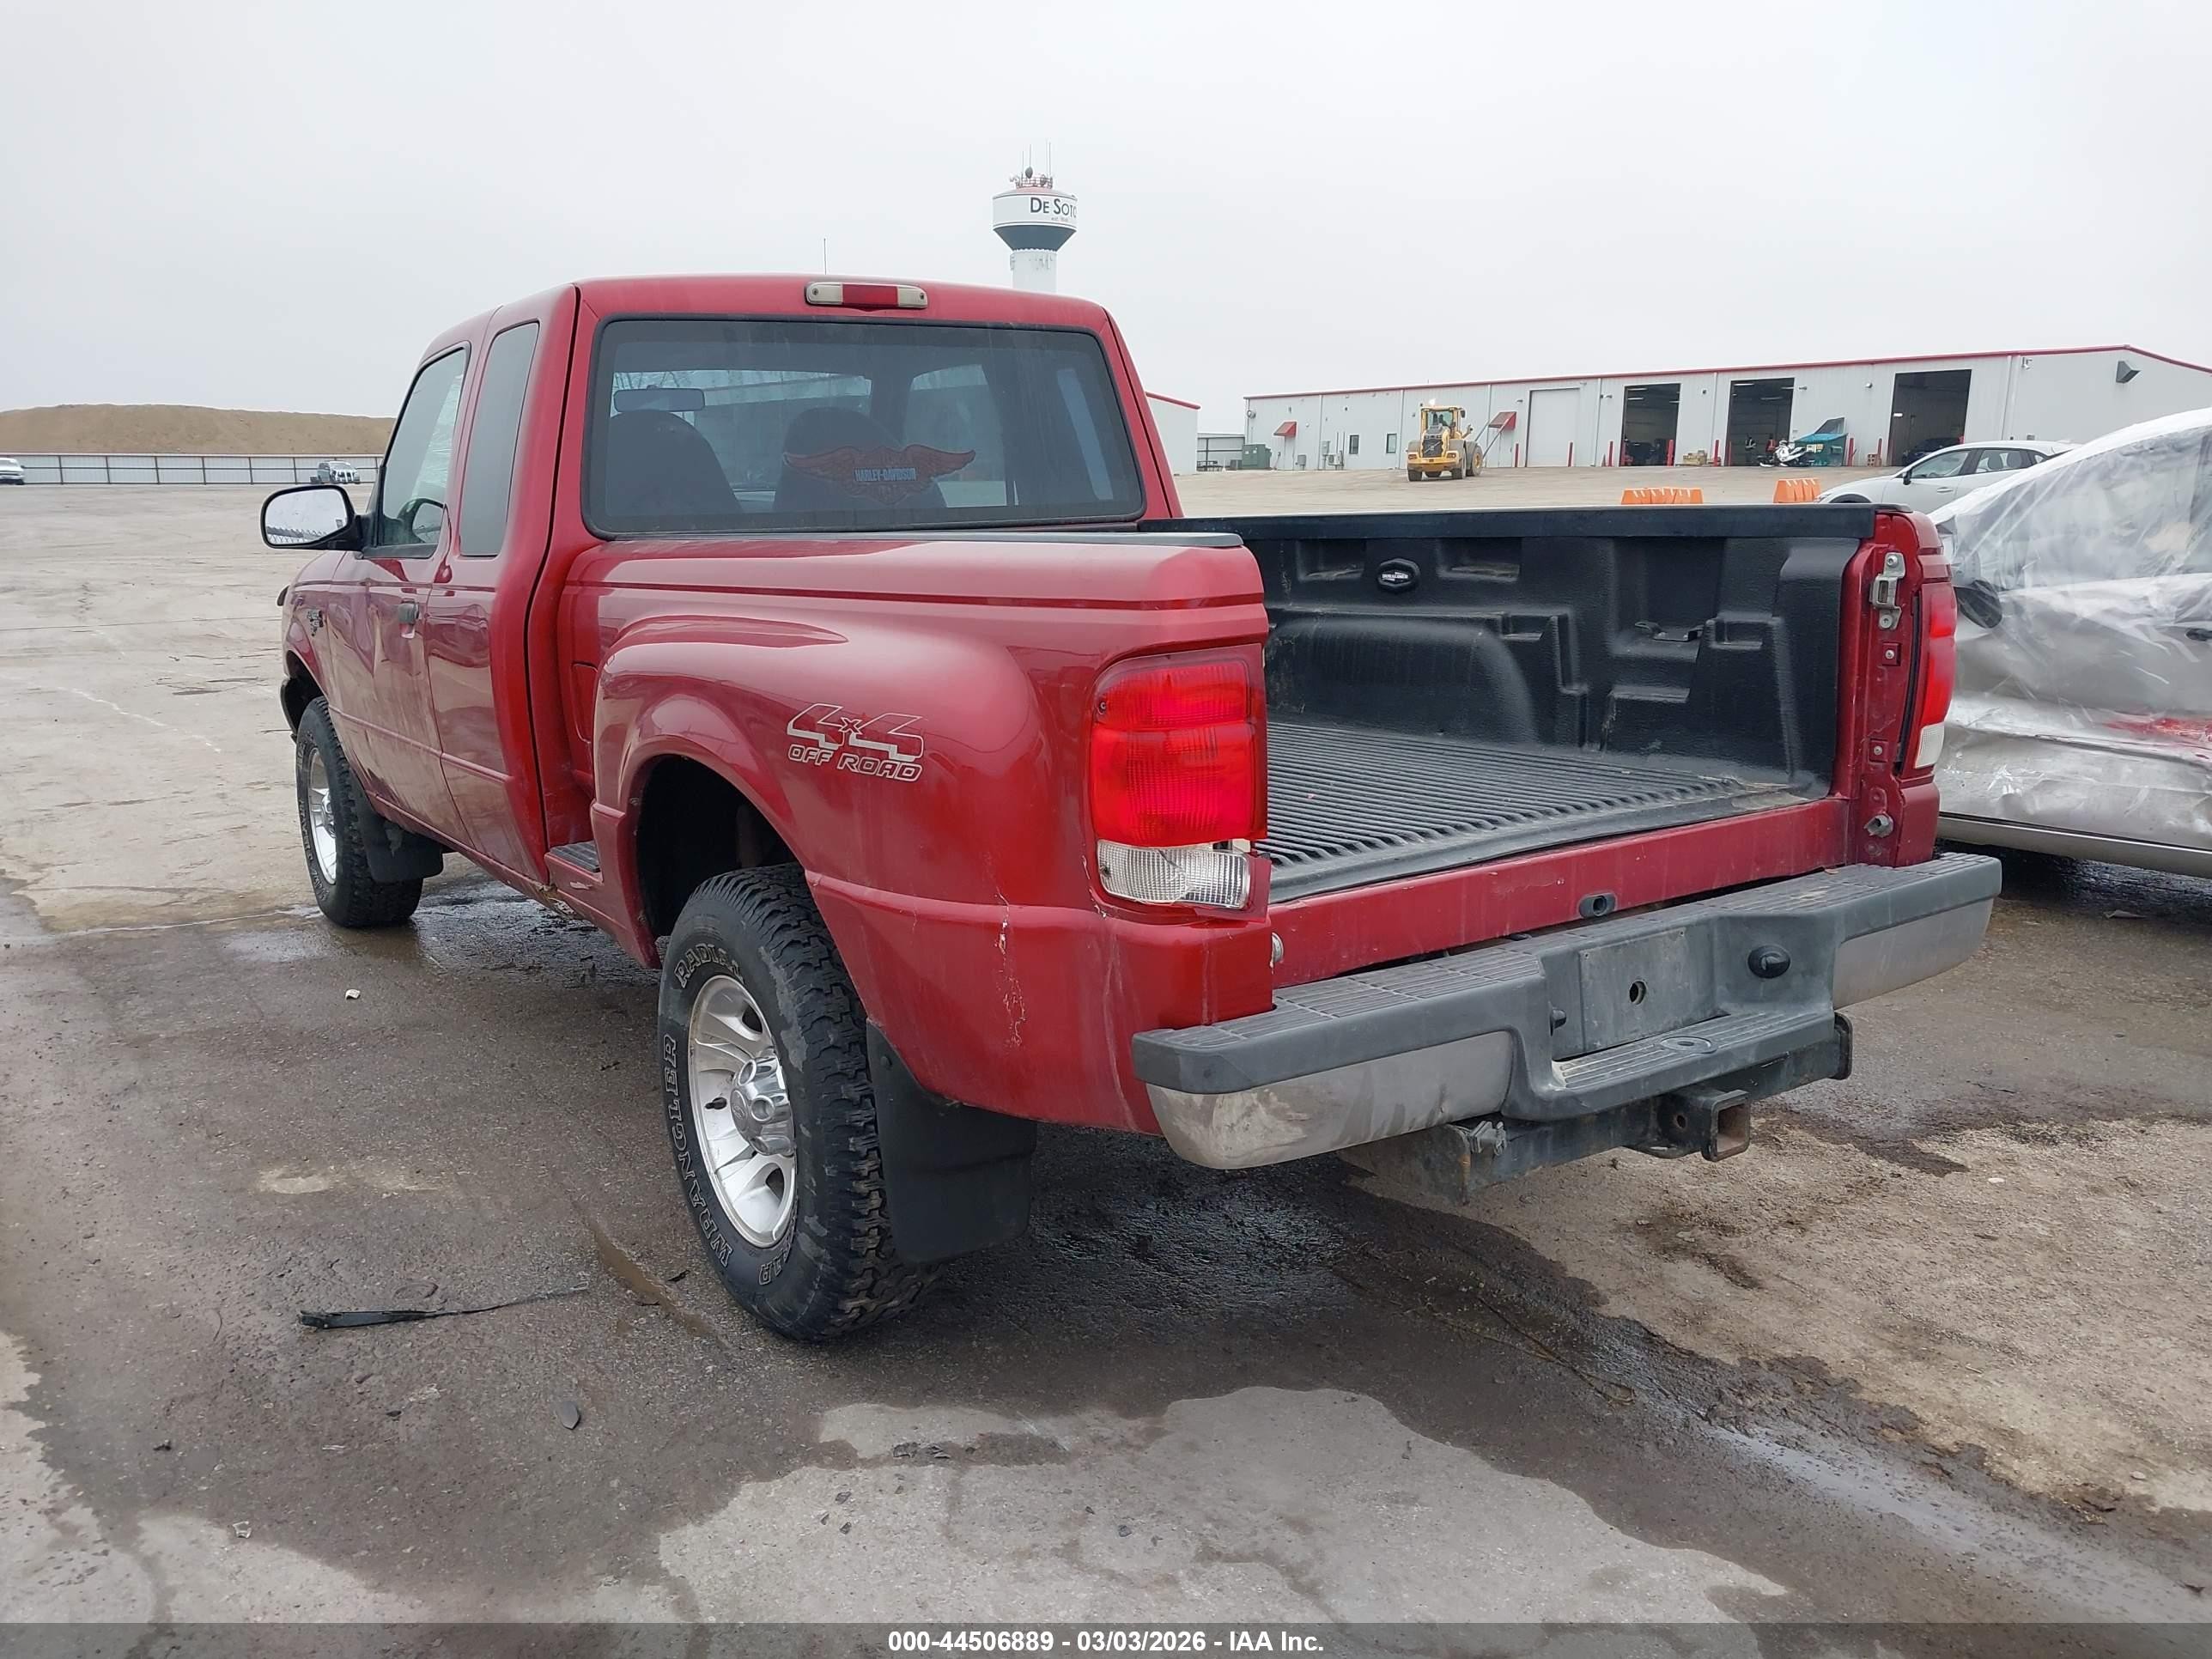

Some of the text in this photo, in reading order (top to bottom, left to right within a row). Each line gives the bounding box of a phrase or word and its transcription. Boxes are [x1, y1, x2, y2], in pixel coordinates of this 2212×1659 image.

[854, 468, 916, 482] HARLEY-DAVIDSON
[787, 744, 923, 782] OFF ROAD
[673, 943, 744, 988] RADIAL
[663, 1032, 733, 1267] WRANGLER
